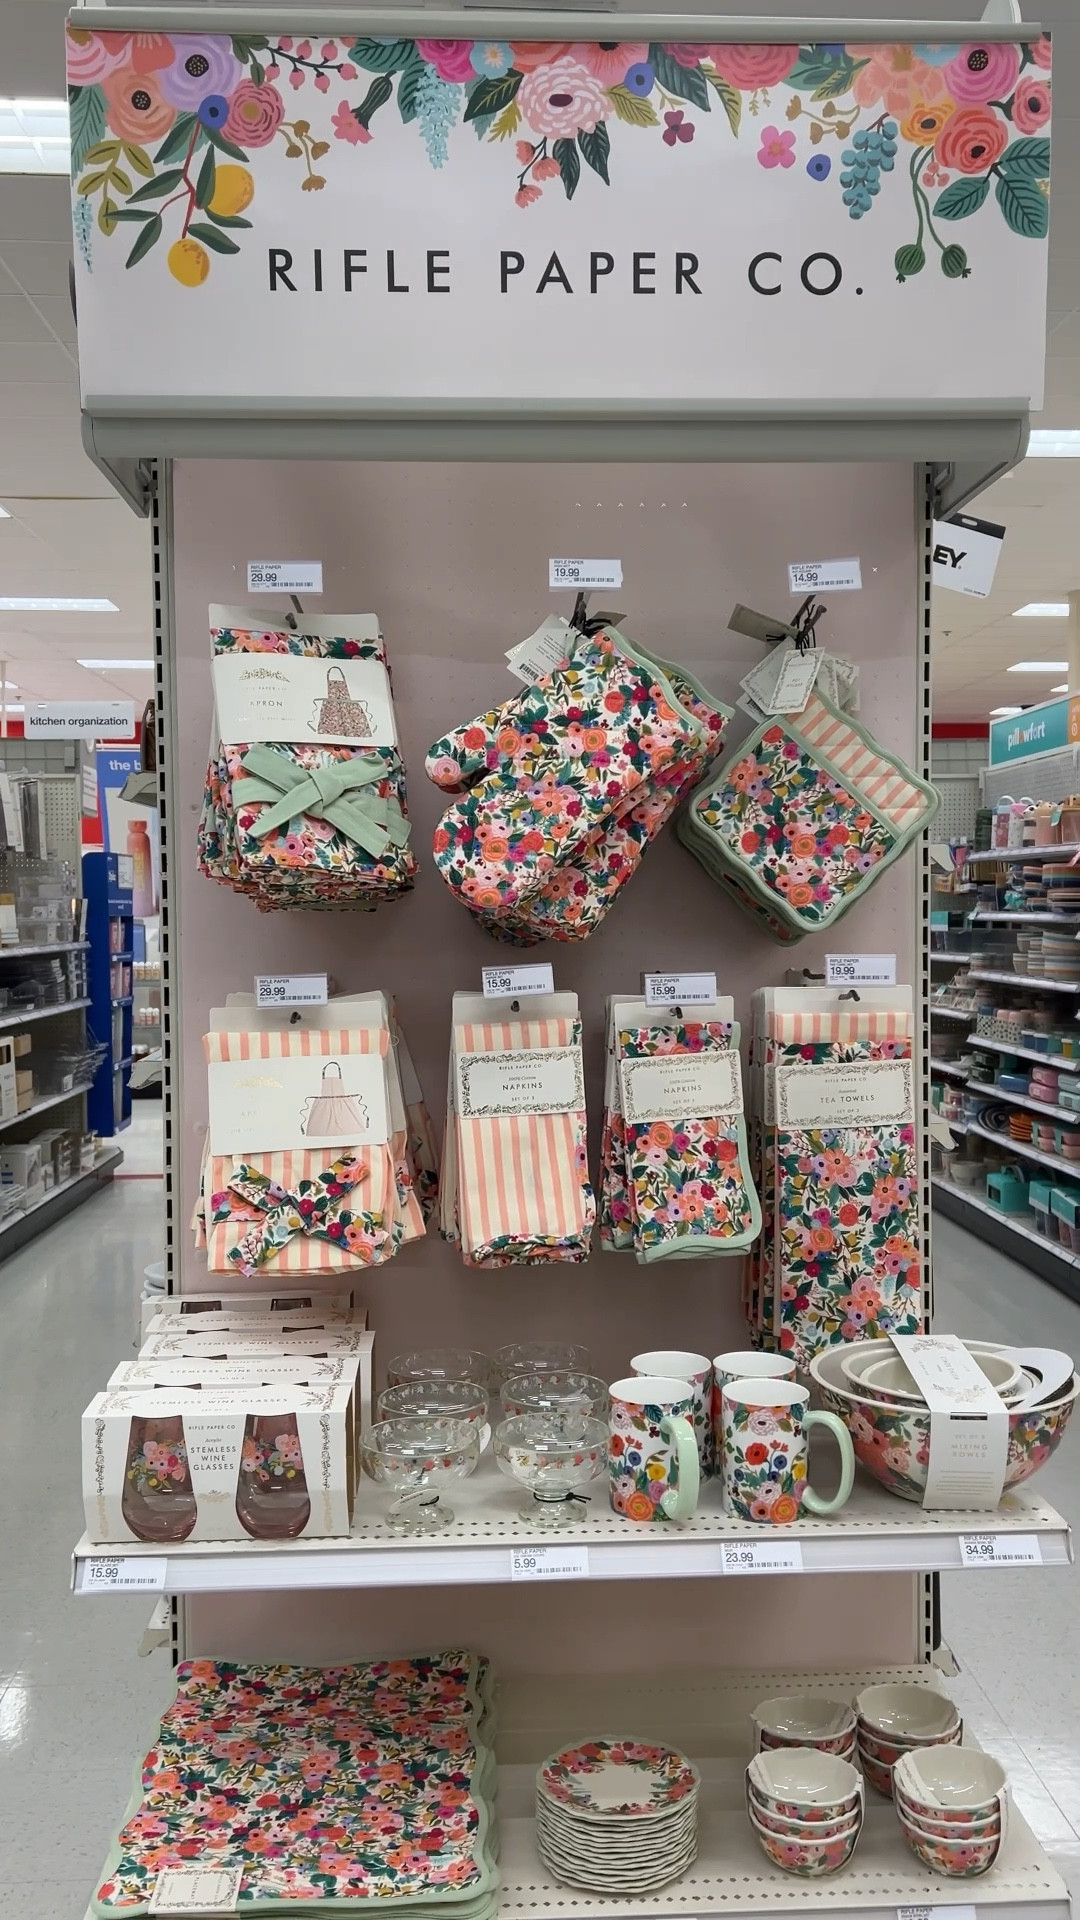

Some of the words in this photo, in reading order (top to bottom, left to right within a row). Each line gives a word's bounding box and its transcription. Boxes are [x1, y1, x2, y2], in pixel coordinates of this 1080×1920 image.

[268, 248, 451, 293] RIFLE
[500, 250, 703, 295] PAPER
[747, 251, 864, 296] CO.
[933, 544, 967, 569] EY
[251, 573, 277, 582] 29.99
[555, 568, 580, 577] 19.99
[793, 572, 818, 583] 14.99
[30, 717, 65, 726] kitchen
[68, 717, 128, 728] organization
[1008, 721, 1046, 752] pillowfort
[108, 760, 131, 771] the
[830, 966, 855, 975] 19.99
[487, 978, 511, 988] 15.99
[260, 987, 286, 996] 29.99
[651, 986, 676, 995] 15.99
[502, 1082, 543, 1091] NAPKINS
[663, 1085, 702, 1094] NAPKINS
[840, 1095, 875, 1103] TOWELS
[190, 1446, 237, 1454] STEMLESS
[193, 1463, 234, 1471] GLASSES
[966, 1544, 994, 1555] 34.99
[726, 1552, 754, 1563] 23.99
[514, 1558, 536, 1569] 5.99
[90, 1567, 119, 1578] 15.99
